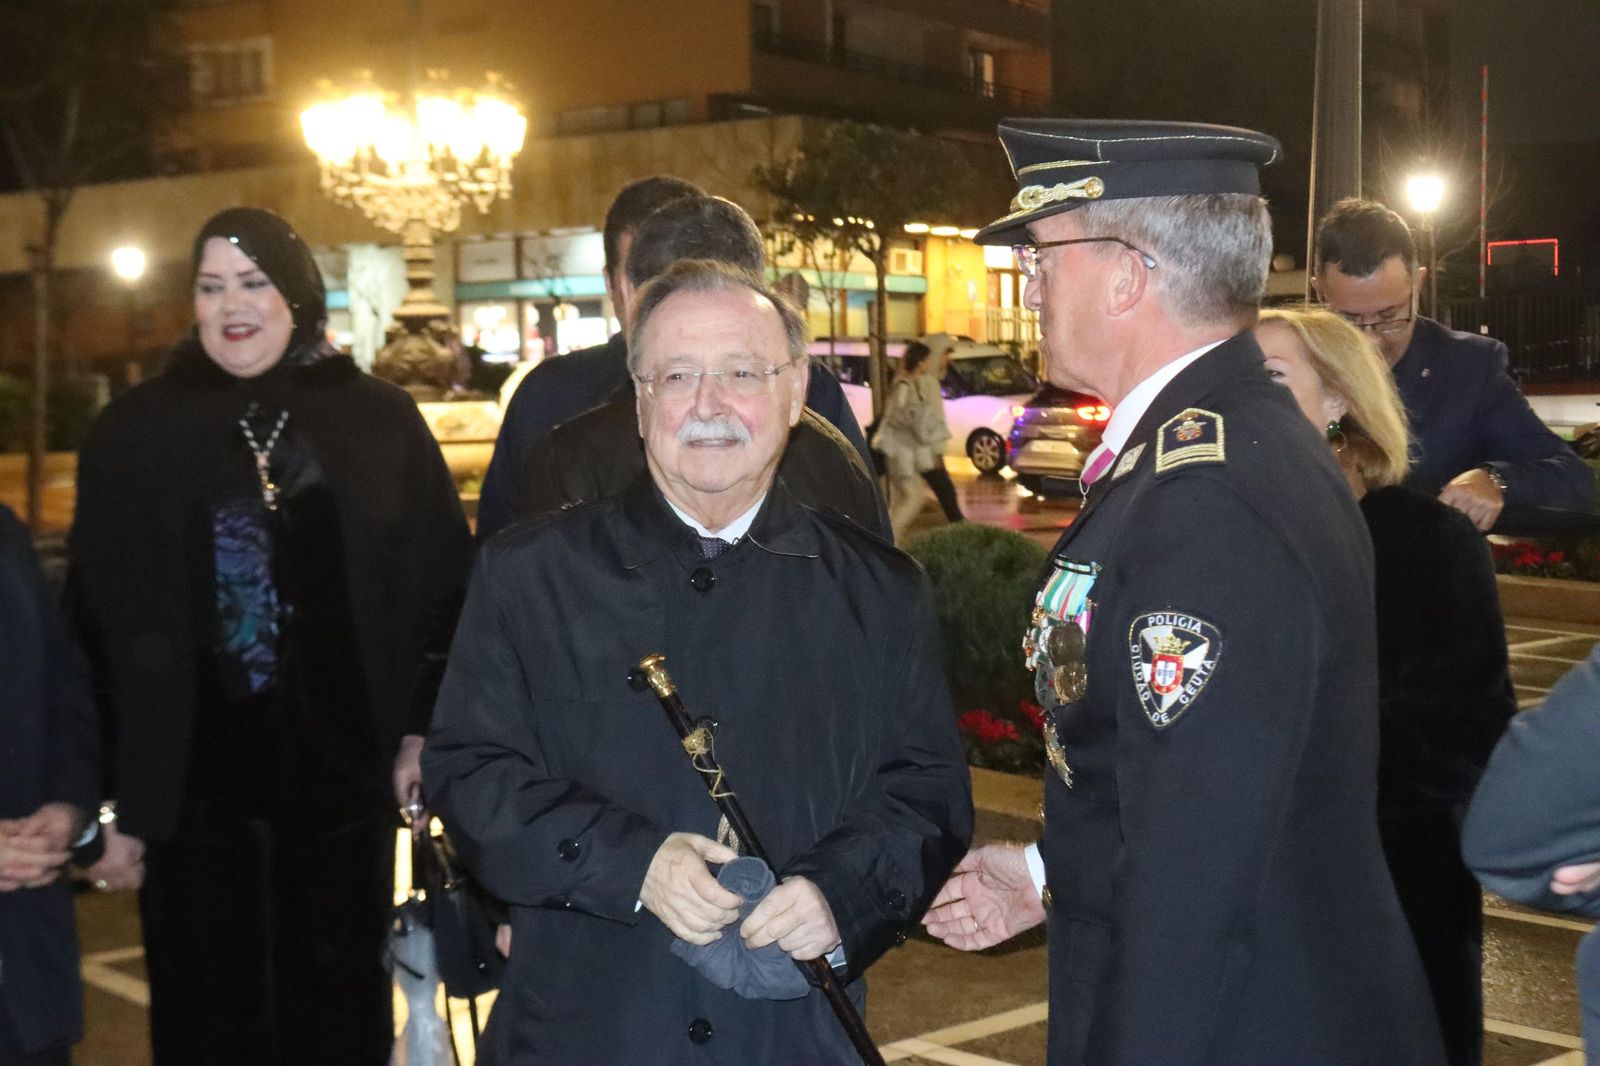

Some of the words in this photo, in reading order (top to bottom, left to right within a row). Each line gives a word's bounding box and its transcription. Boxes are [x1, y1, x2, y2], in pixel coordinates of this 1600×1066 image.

[1147, 614, 1202, 634] POLICIA
[1179, 660, 1214, 705] CEUTA
[1151, 711, 1170, 723] DE
